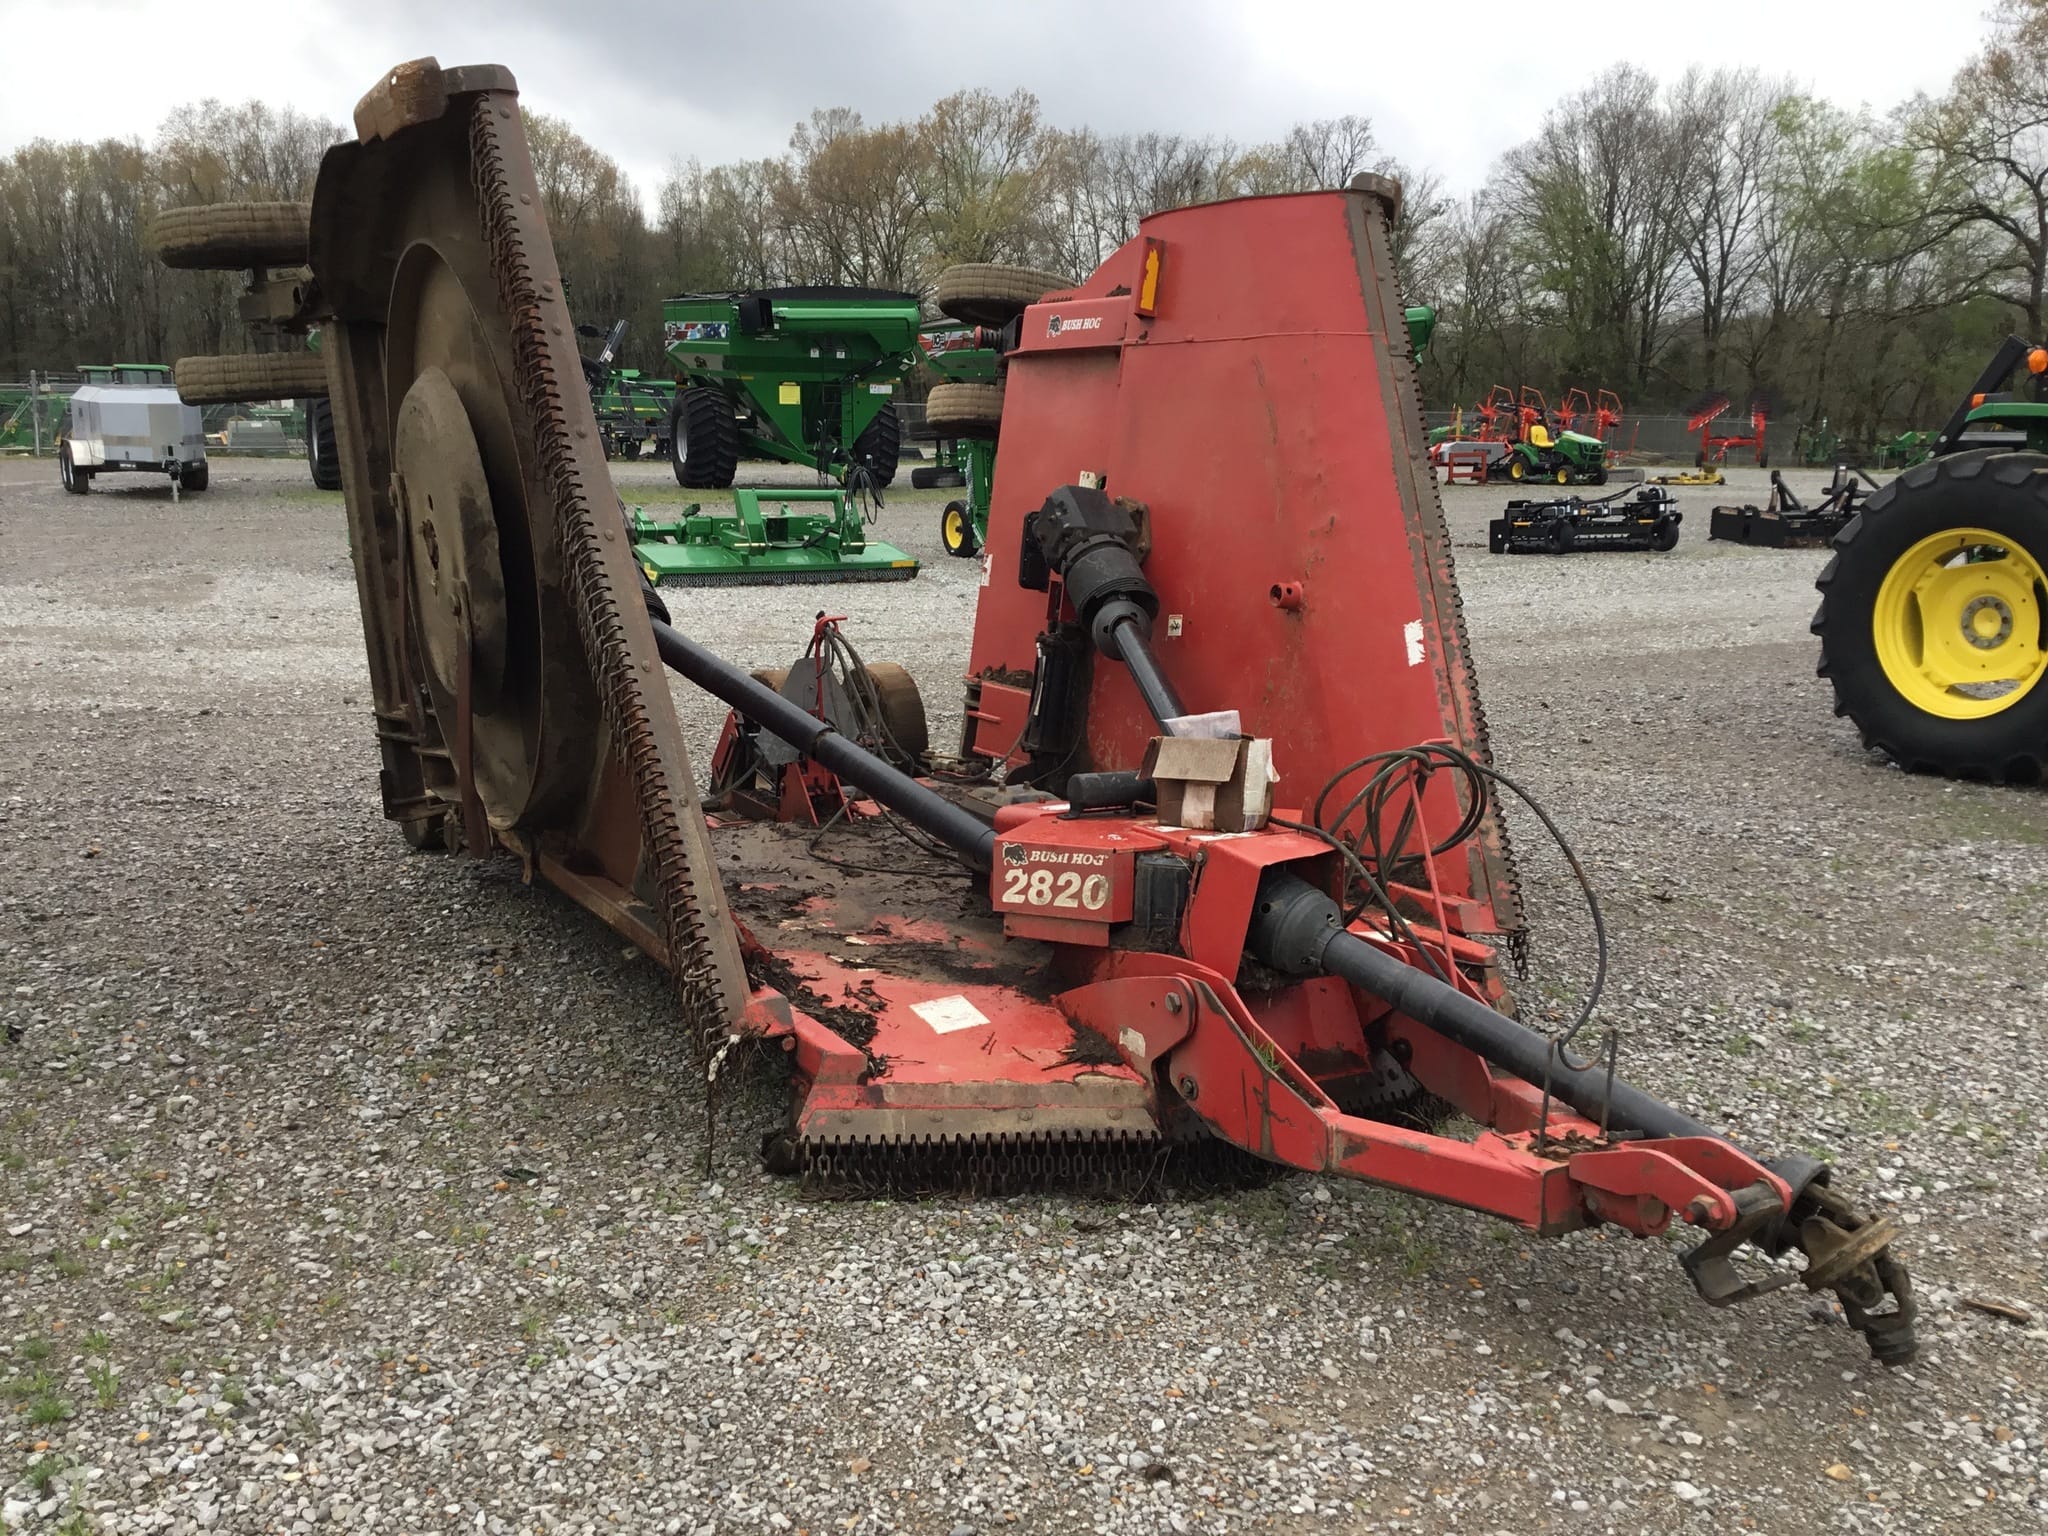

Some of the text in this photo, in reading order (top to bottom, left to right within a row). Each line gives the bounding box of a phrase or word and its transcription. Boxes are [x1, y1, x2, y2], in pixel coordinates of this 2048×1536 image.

[1061, 317, 1102, 331] BUSH HOG
[1030, 850, 1108, 866] BUSH HOG
[1002, 868, 1109, 911] 2820
